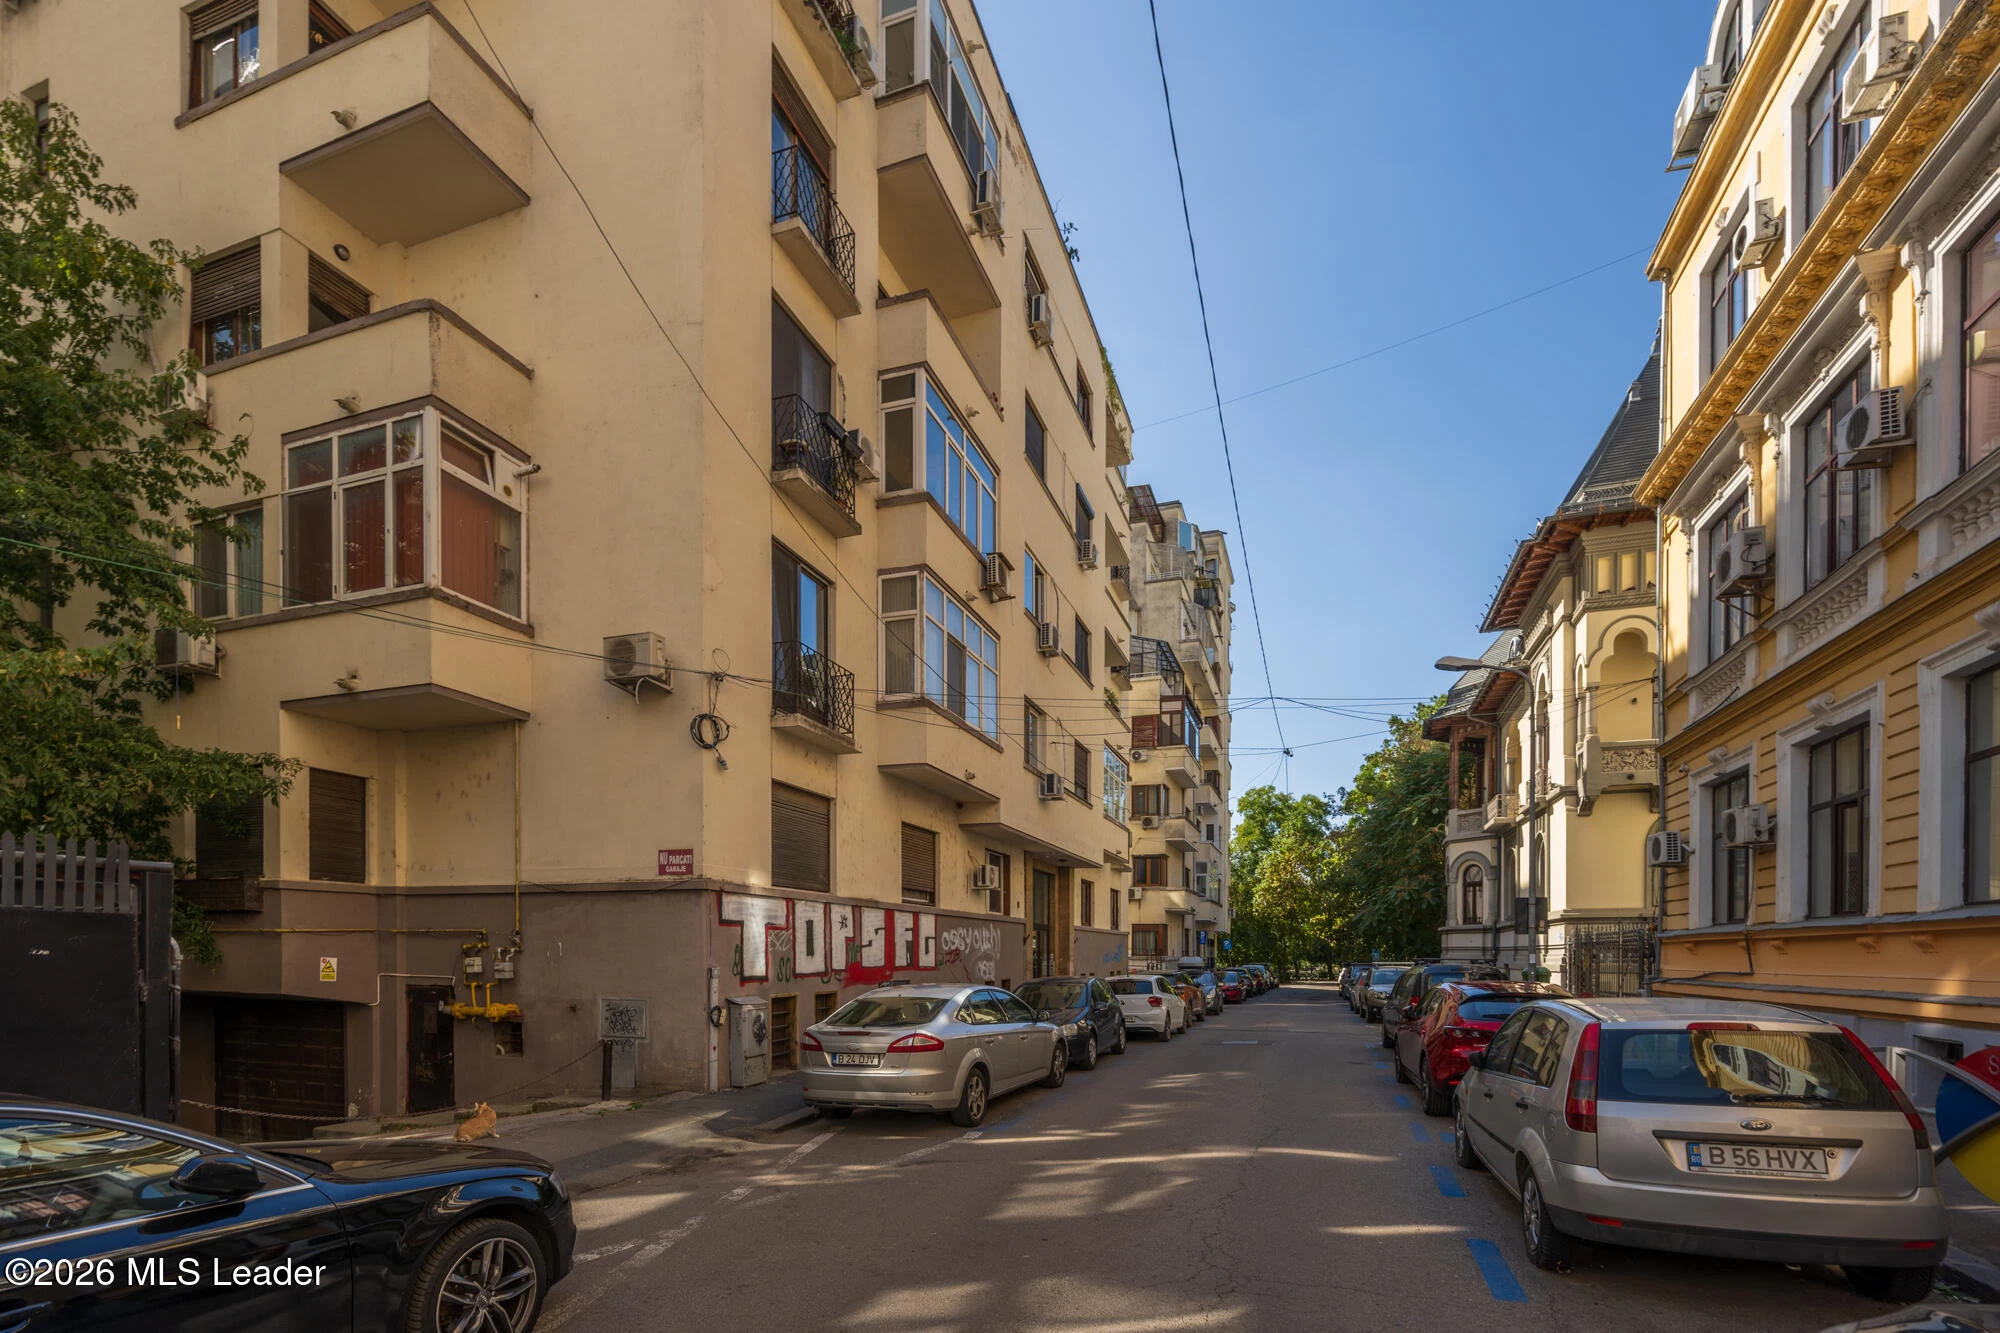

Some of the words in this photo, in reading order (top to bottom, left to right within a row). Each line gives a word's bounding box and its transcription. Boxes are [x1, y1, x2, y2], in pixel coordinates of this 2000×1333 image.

[660, 852, 668, 864] NU
[669, 855, 692, 864] PARCATI
[838, 1054, 844, 1064] B
[846, 1054, 856, 1064] 24
[1708, 1146, 1725, 1165] B
[1732, 1147, 1760, 1167] 56
[1765, 1149, 1818, 1170] HVX
